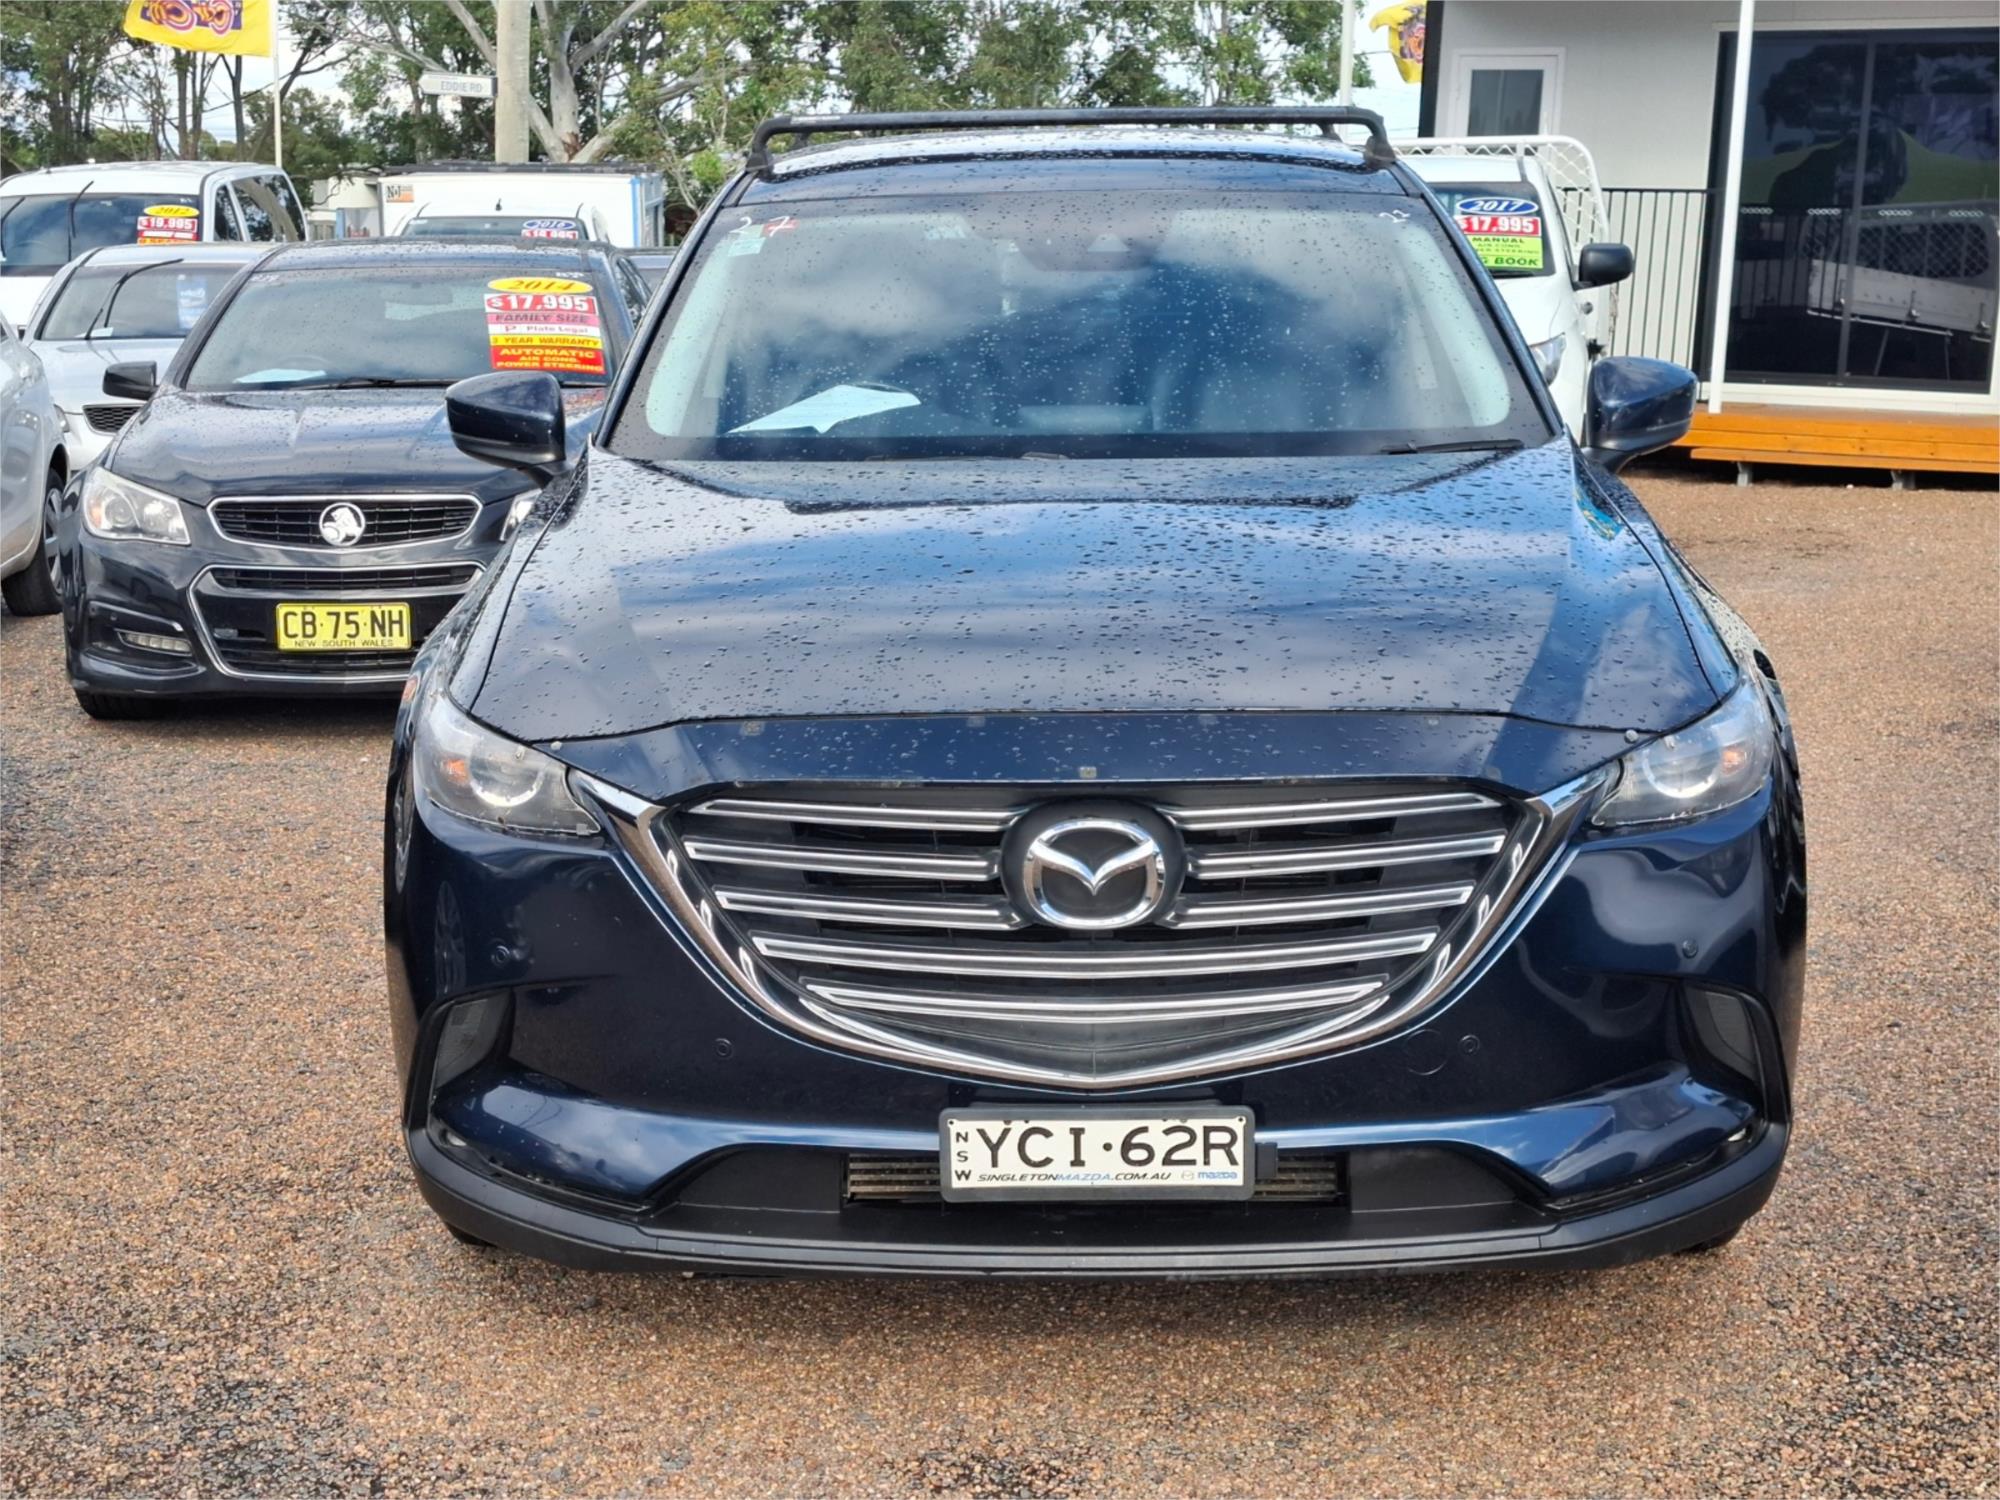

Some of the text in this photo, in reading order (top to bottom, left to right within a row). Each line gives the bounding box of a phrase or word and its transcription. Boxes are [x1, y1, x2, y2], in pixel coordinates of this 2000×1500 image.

[1472, 200, 1522, 211] 2017
[1458, 216, 1534, 233] $17,995
[1472, 236, 1525, 244] MANUAL
[1494, 257, 1538, 266] BOOK
[507, 279, 577, 291] 2014
[490, 294, 589, 312] $17,995
[495, 314, 552, 322] FAMILY
[558, 326, 588, 334] Legal
[539, 337, 600, 346] WARRANTY
[500, 348, 596, 359] AUTOMATIC
[543, 362, 604, 372] STEERING
[322, 639, 356, 647] SOUTH
[361, 639, 394, 647] WALES
